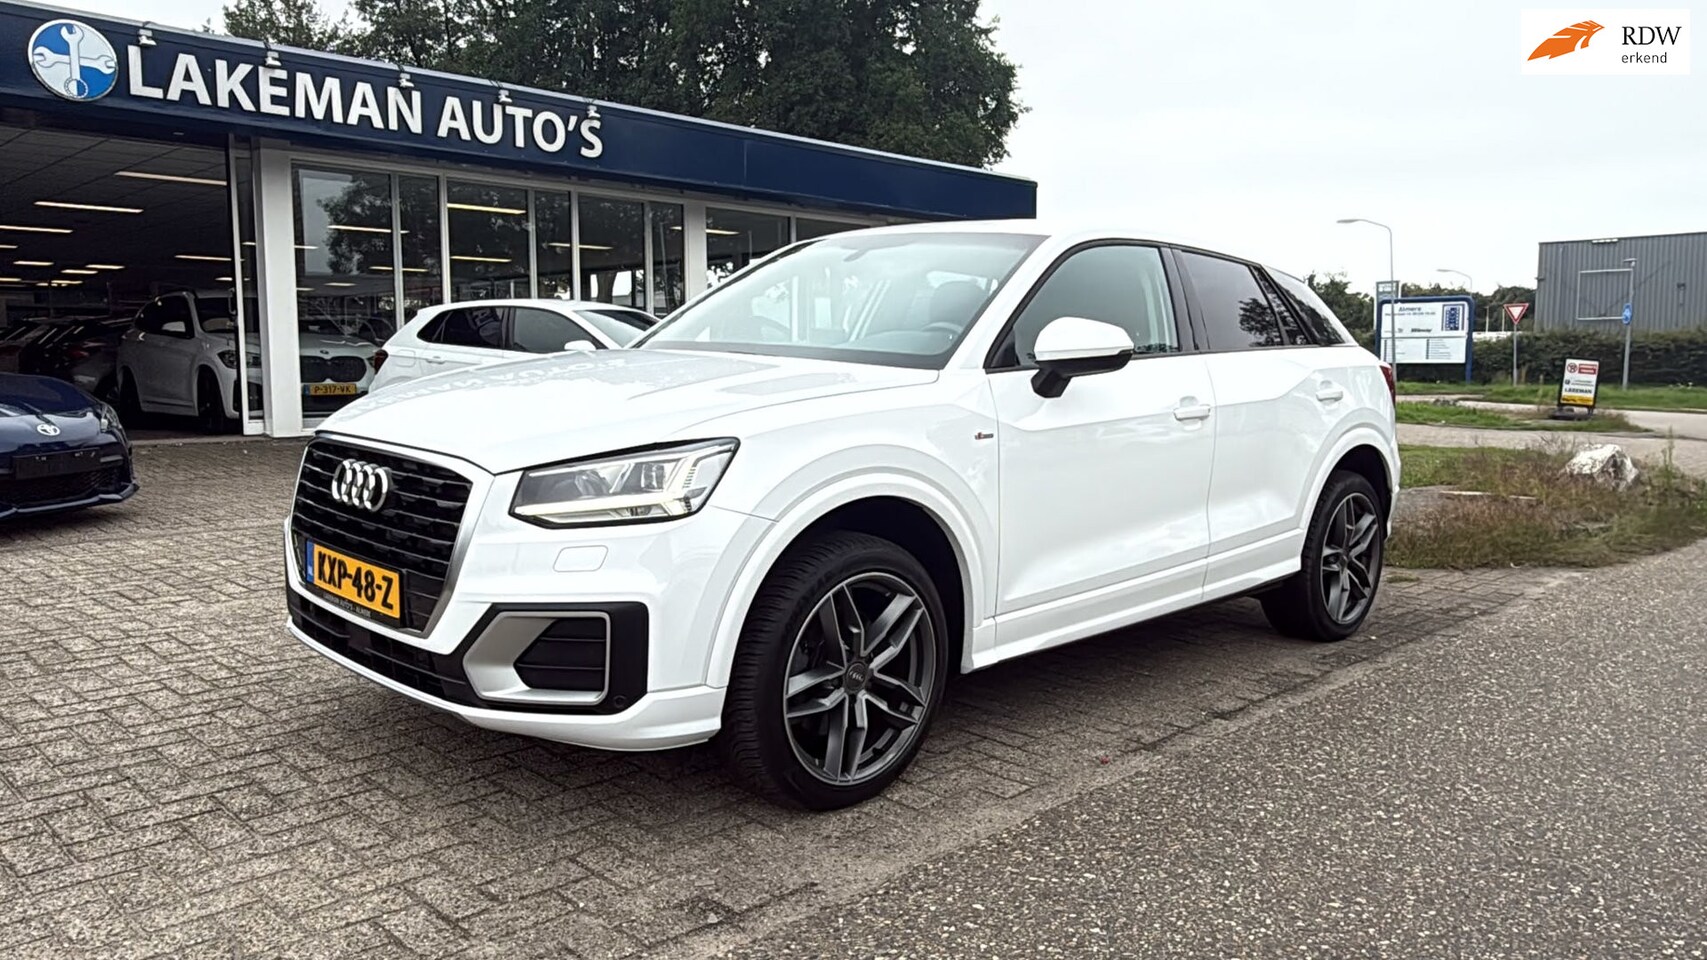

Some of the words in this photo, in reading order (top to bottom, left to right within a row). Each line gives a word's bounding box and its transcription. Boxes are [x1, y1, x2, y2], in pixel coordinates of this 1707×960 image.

[127, 44, 423, 135] LAKEMAN
[436, 96, 604, 159] AUTO'S
[317, 550, 394, 611] KXP-48-Z
